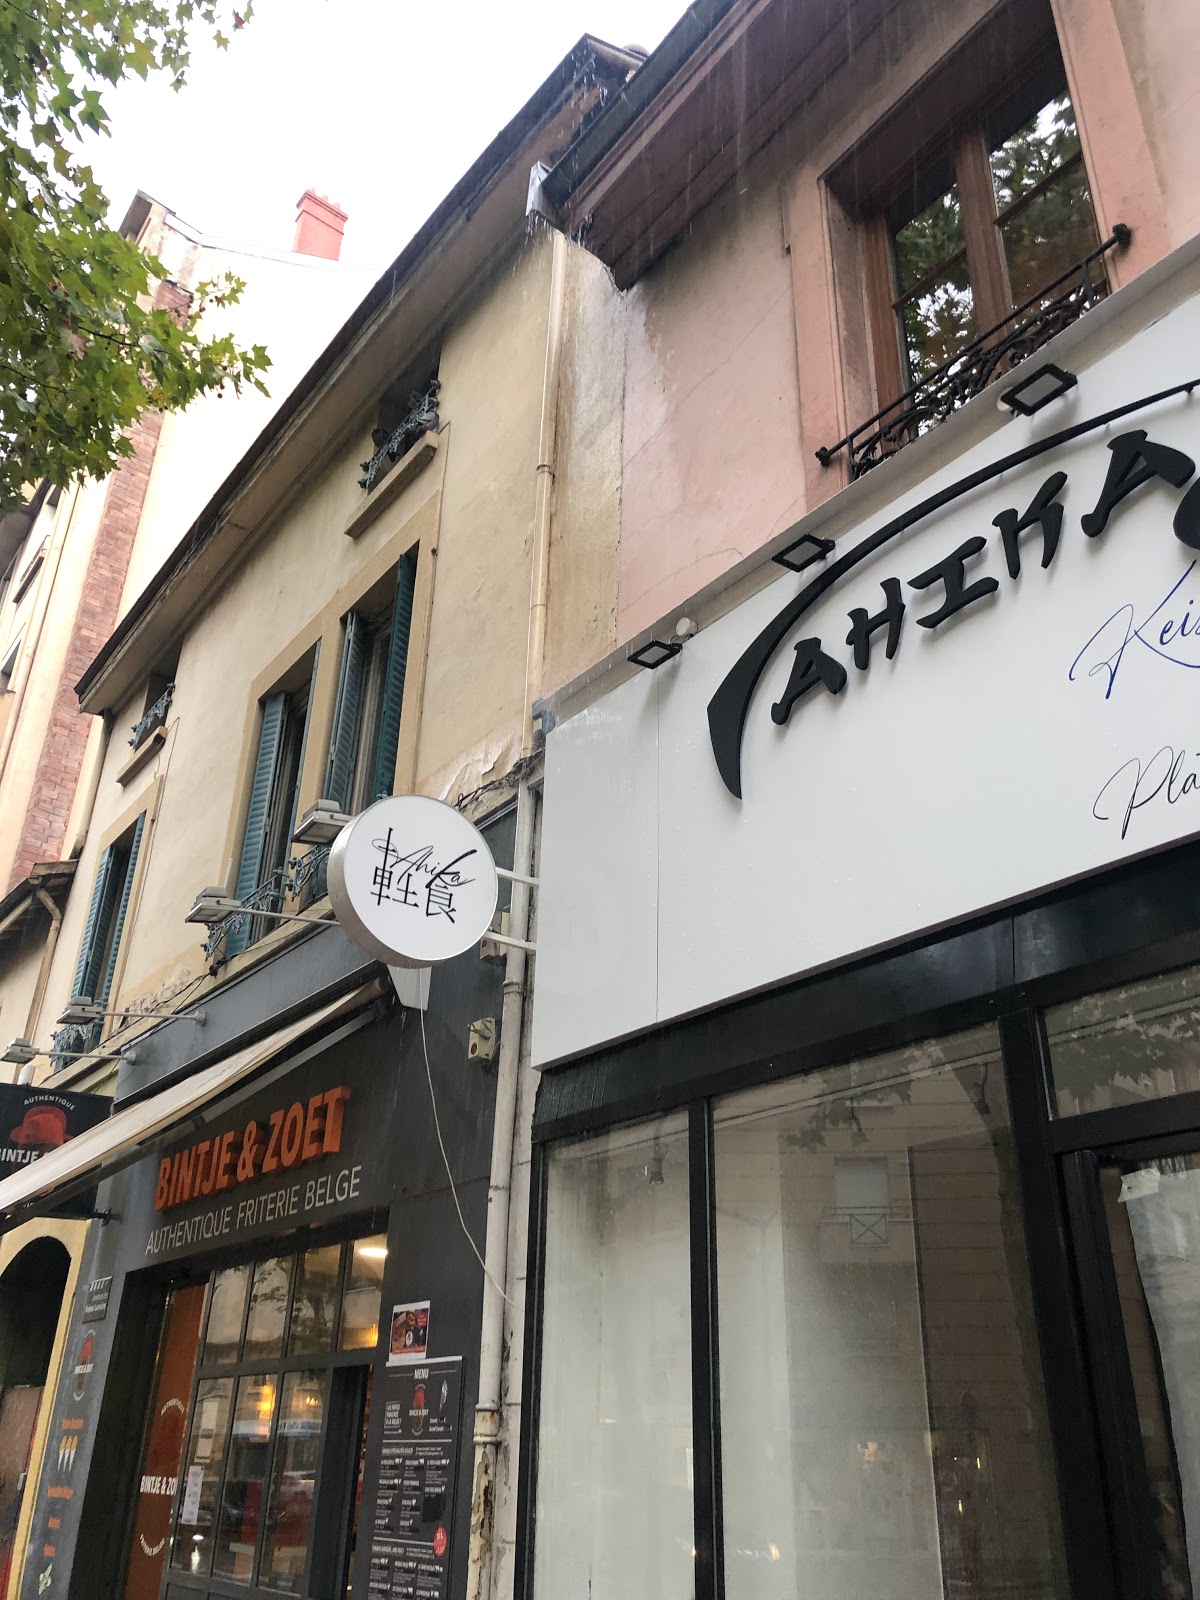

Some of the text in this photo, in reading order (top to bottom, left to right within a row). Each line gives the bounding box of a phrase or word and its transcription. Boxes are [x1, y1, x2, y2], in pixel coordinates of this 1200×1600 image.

[770, 429, 1196, 726] AHIKA
[1092, 745, 1200, 840] Pla
[23, 1094, 76, 1112] AUTHENTIQUE
[153, 1086, 351, 1212] BINTJE & ZOET
[144, 1165, 362, 1256] AUTHENTIQUE FRITERIE BELGE
[139, 1475, 161, 1494] BINTJE
